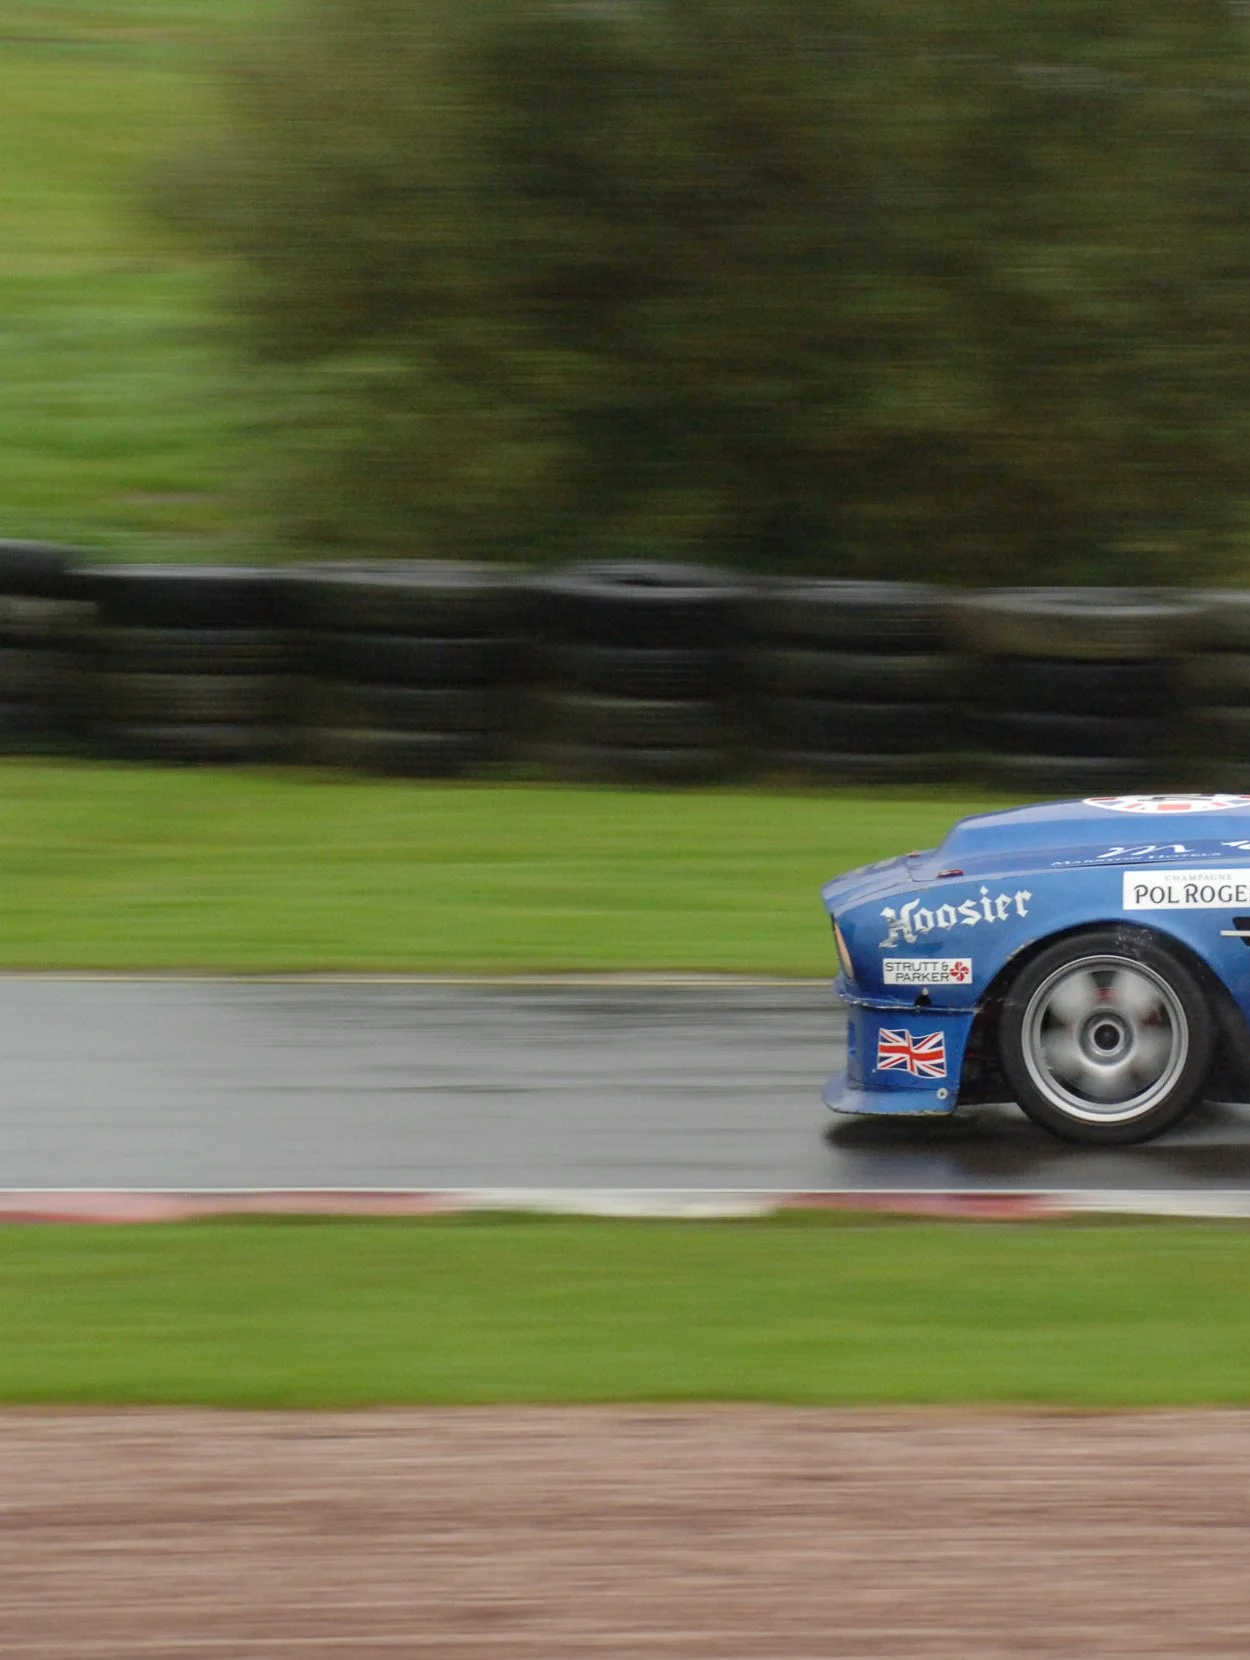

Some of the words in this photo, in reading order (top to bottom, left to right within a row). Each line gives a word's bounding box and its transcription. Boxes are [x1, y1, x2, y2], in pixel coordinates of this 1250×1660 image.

[1164, 873, 1233, 882] CHAMPAGNE
[1133, 884, 1179, 904] POL
[879, 885, 1032, 948] Hoosier
[884, 961, 938, 972] STRUTT
[941, 961, 949, 972] &
[895, 972, 950, 982] PARKER
